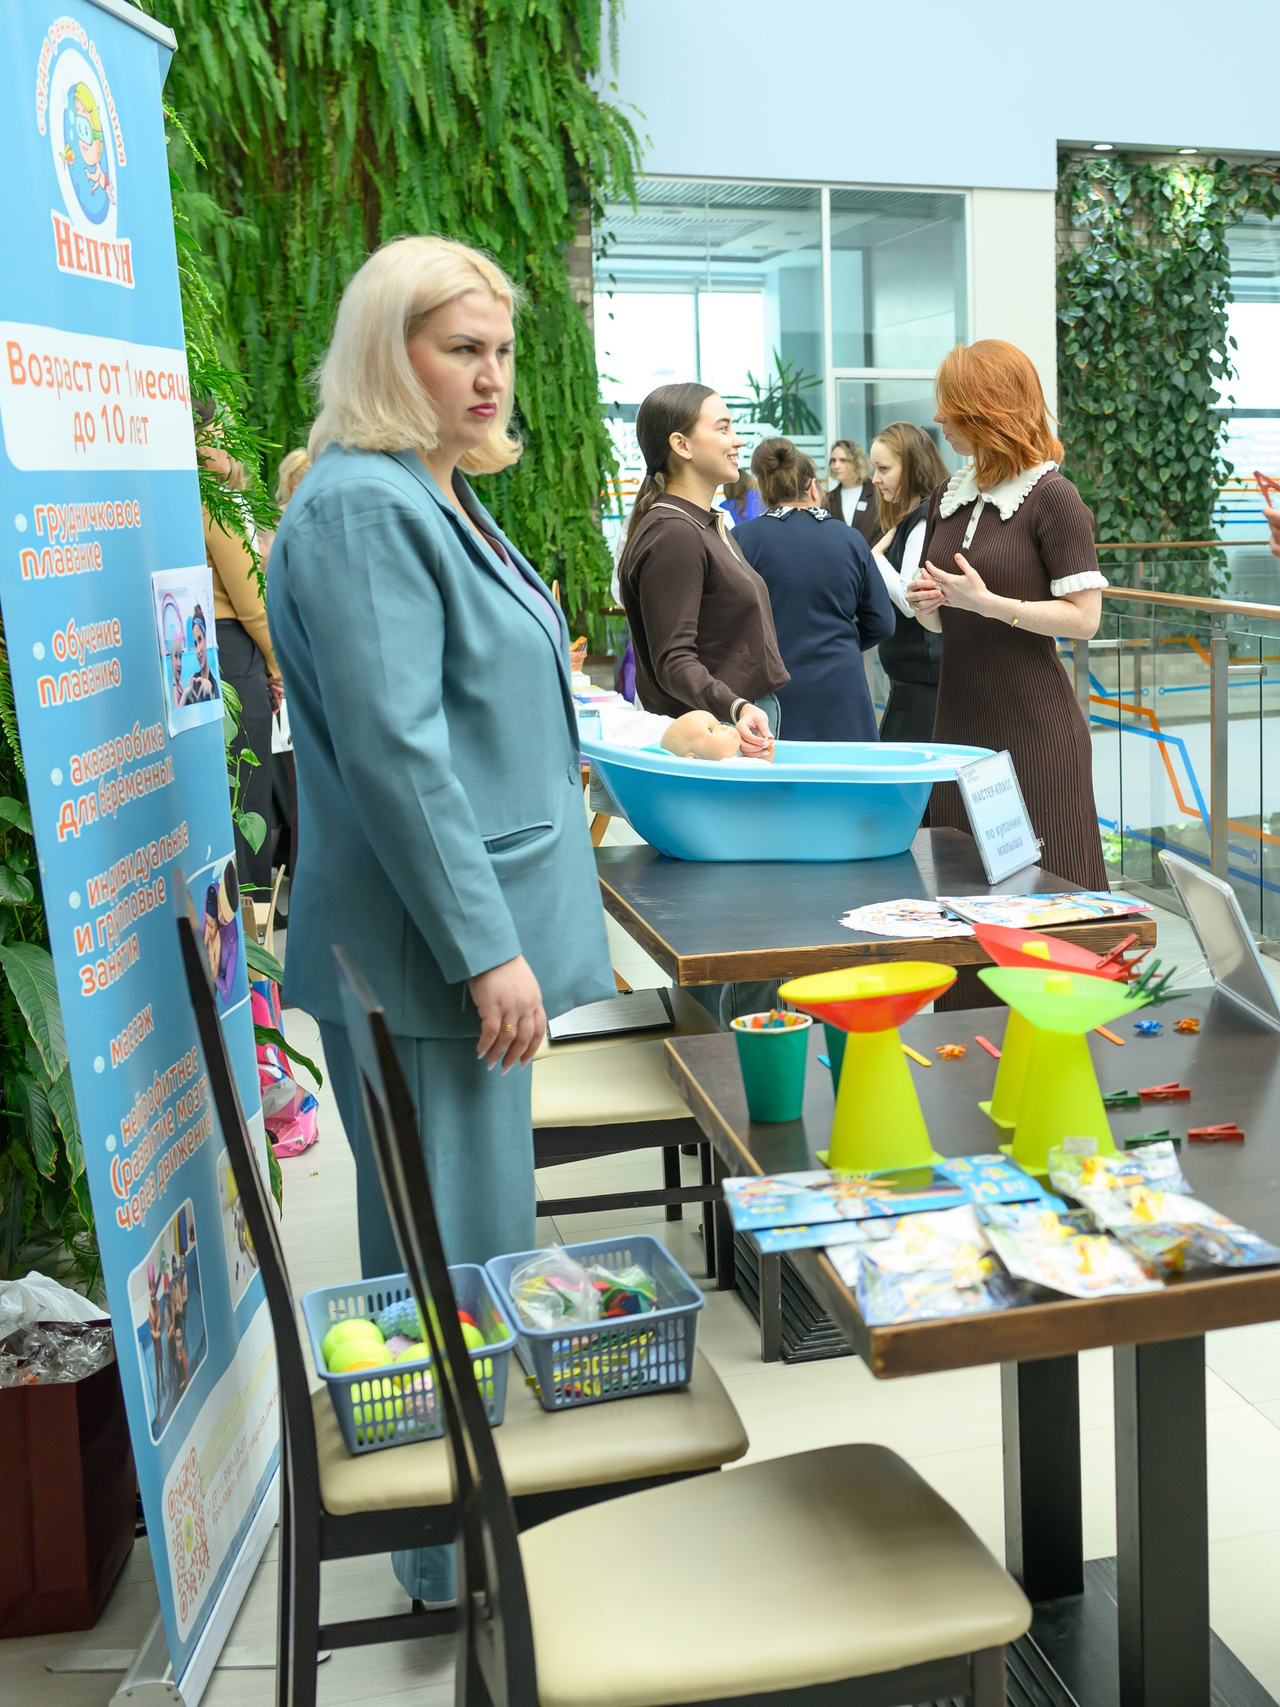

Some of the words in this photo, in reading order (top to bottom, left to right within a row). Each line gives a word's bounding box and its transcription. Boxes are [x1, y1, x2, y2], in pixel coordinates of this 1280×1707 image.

[6, 340, 93, 401] Возраст
[99, 363, 121, 394] от
[125, 359, 132, 396] 1
[73, 411, 96, 453] до
[101, 404, 125, 444] 10
[129, 415, 149, 445] лет
[35, 502, 140, 542] грудничковое
[21, 542, 102, 579] плавание
[53, 618, 121, 664] обучение
[38, 660, 121, 706] плаванию
[99, 777, 174, 818] беременных
[971, 779, 1013, 804] МАСТЕР-КЛАСС
[985, 828, 996, 840] по
[995, 816, 1022, 838] купанию
[997, 837, 1024, 856] малыша
[87, 821, 189, 909] индивидуальные
[74, 922, 94, 956] и
[96, 876, 166, 950] групповые
[80, 933, 140, 996] занятия
[110, 1003, 154, 1069] массаж
[120, 1046, 199, 1147] нейрофитнес
[110, 1108, 175, 1199] (развитие
[176, 1073, 209, 1127] мозга
[116, 1172, 156, 1231] через
